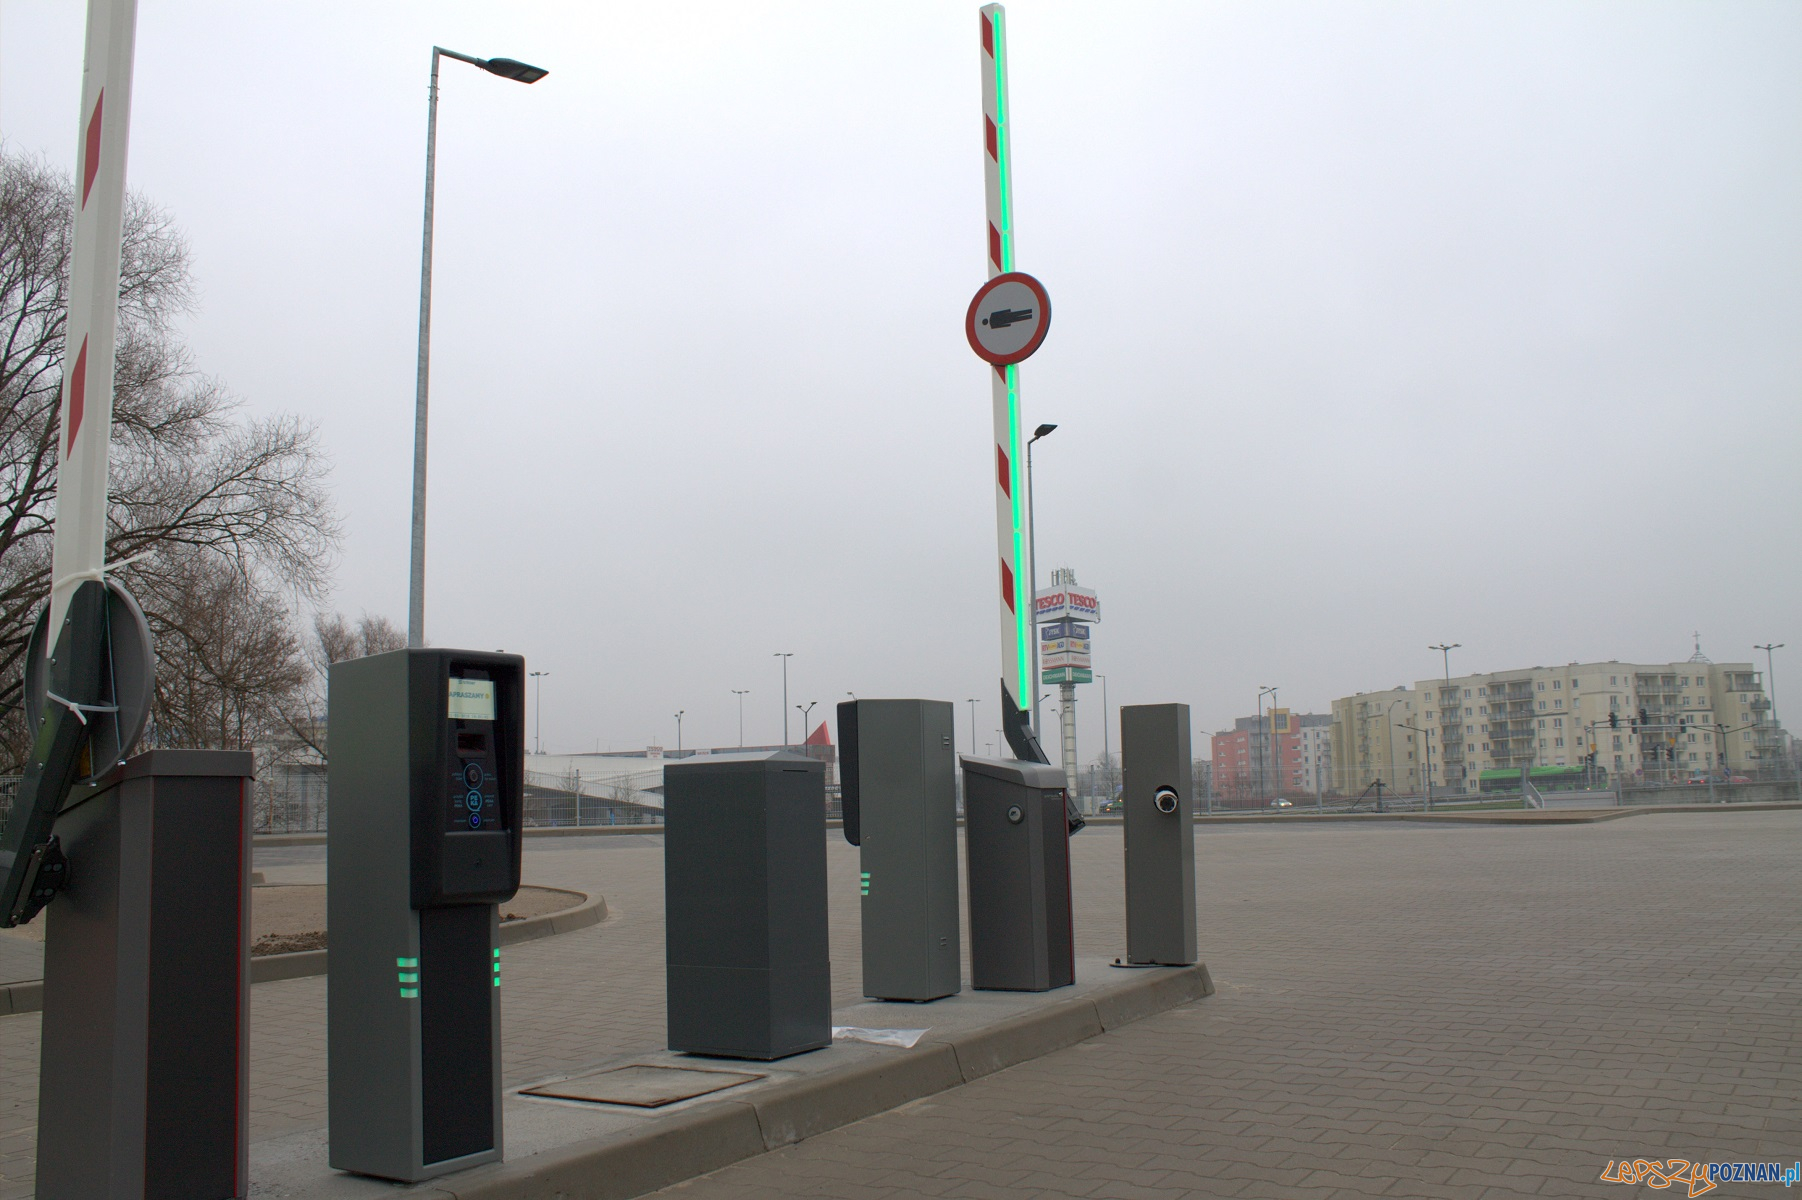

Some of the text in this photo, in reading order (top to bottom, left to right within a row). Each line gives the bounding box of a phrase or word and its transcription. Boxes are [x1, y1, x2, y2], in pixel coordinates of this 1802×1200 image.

[1036, 593, 1065, 610] TESCO
[1068, 592, 1097, 609] TESCO
[1042, 672, 1065, 680] DEICHMANN
